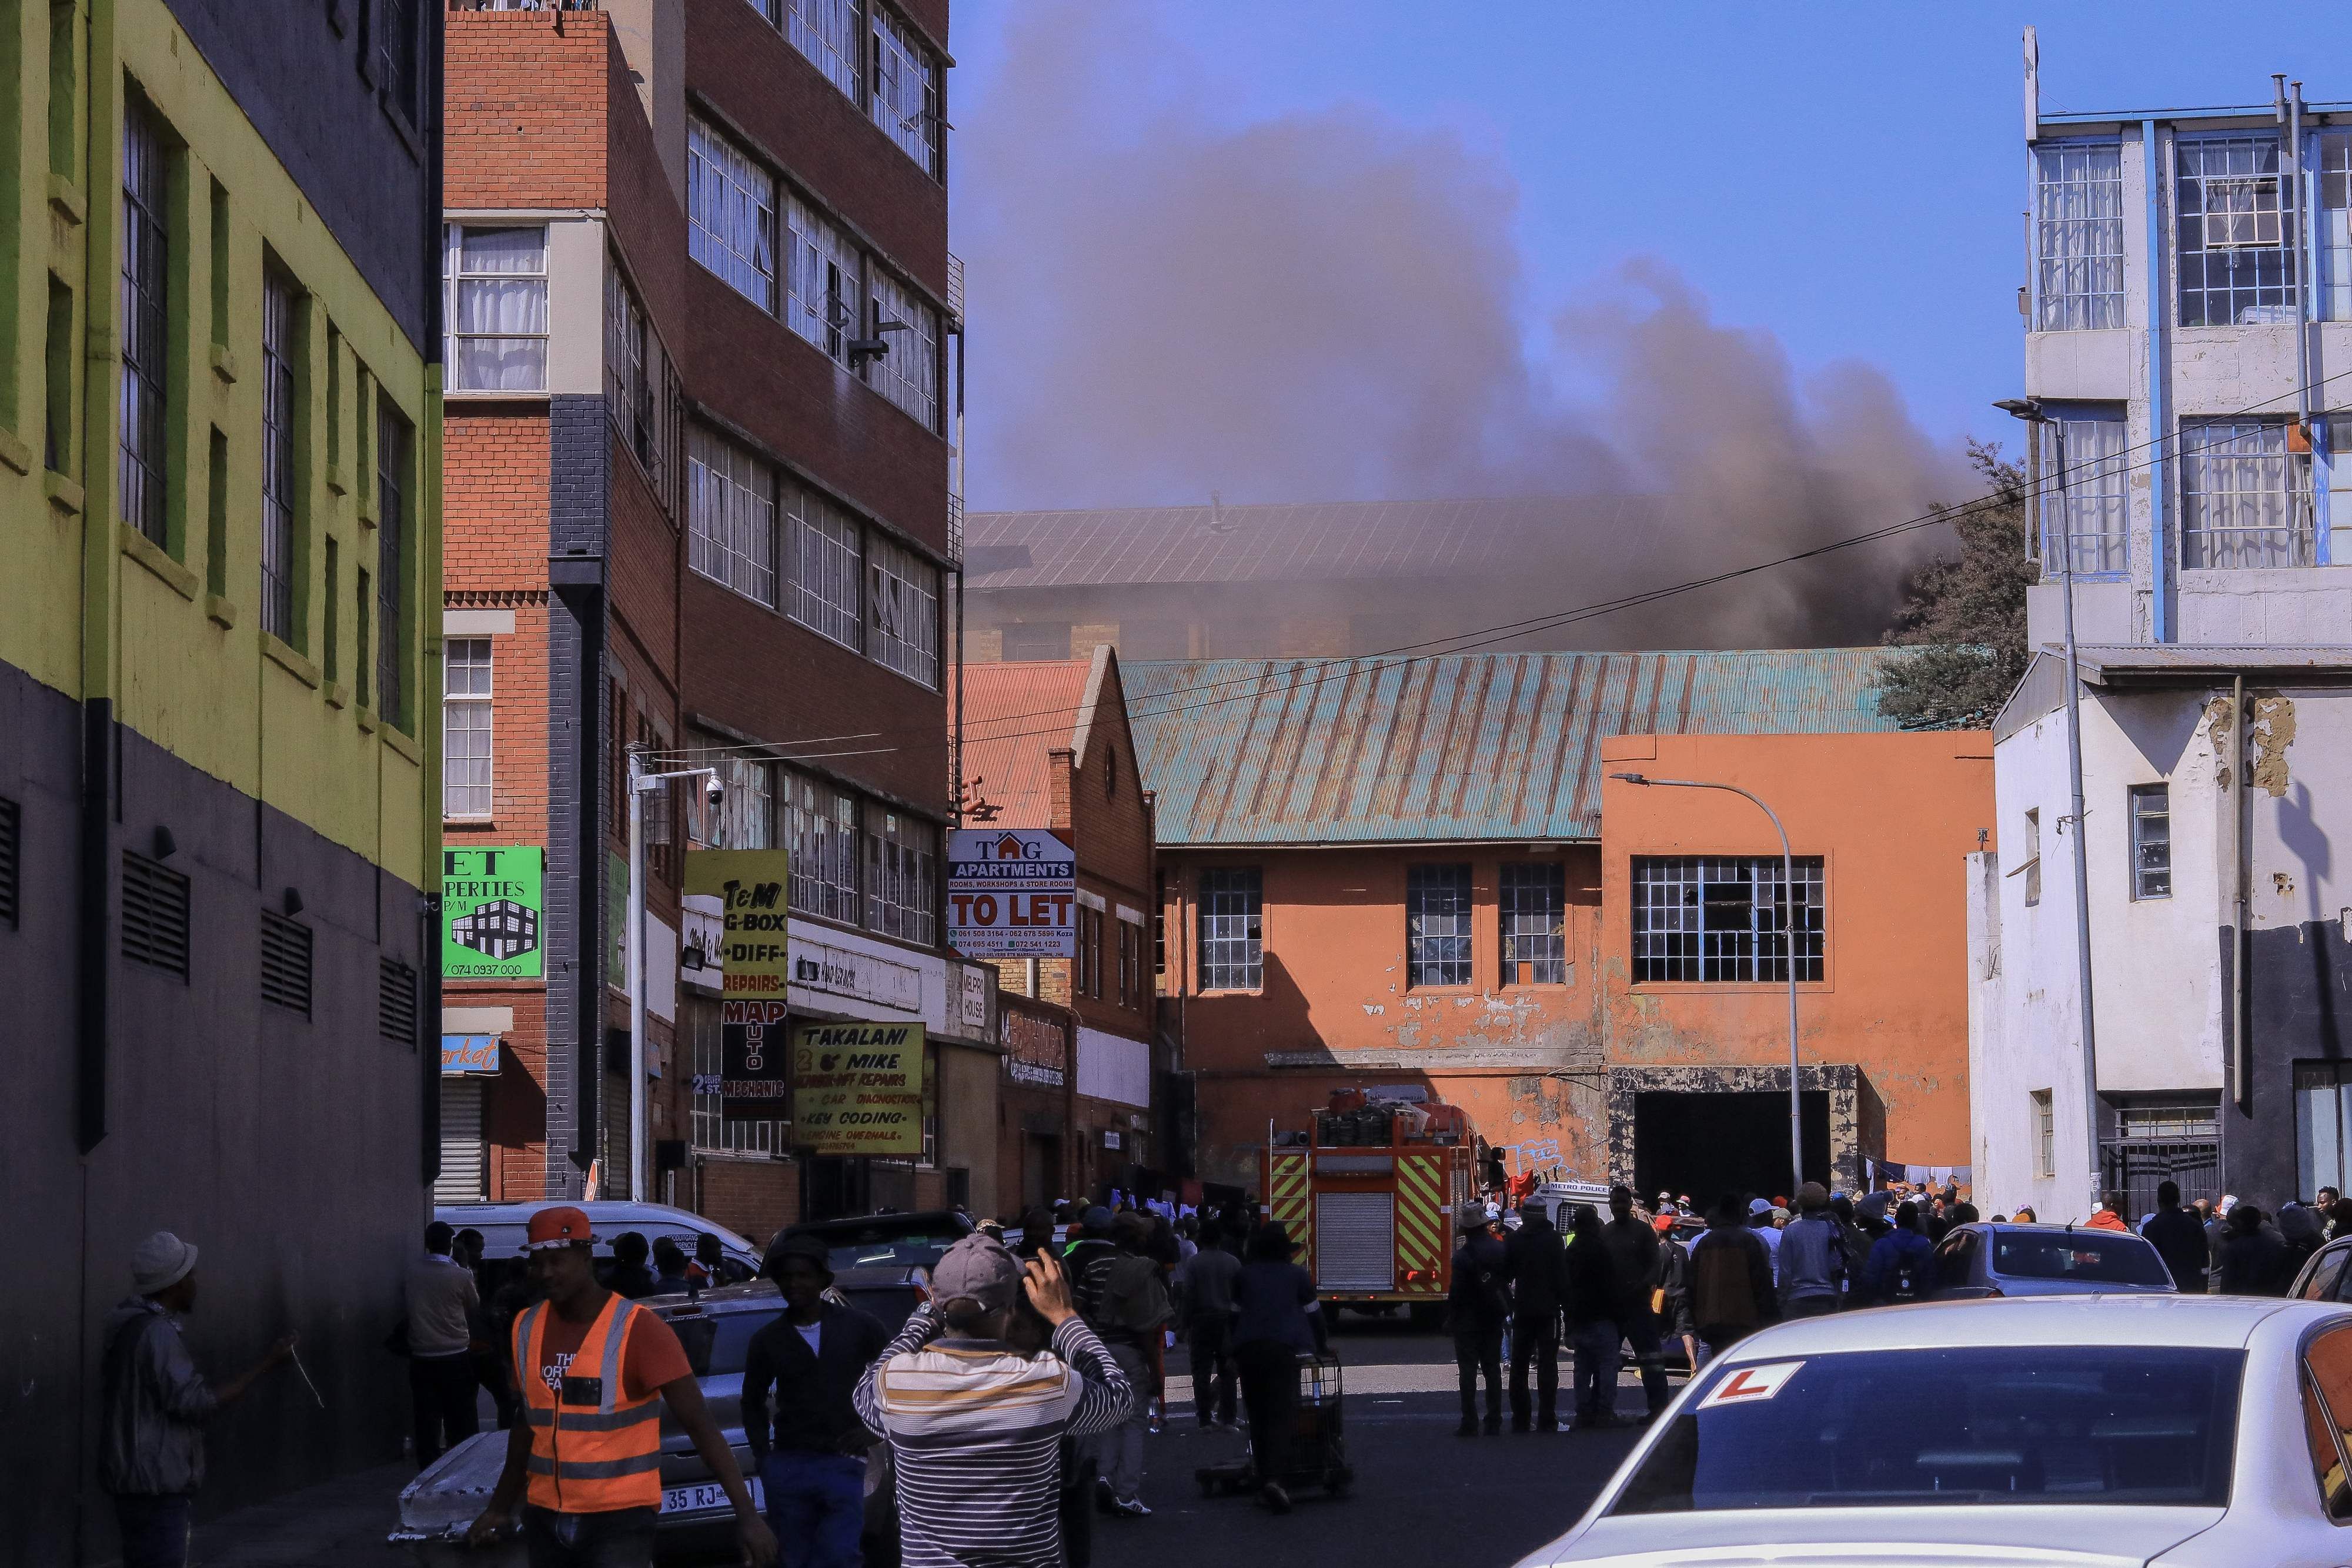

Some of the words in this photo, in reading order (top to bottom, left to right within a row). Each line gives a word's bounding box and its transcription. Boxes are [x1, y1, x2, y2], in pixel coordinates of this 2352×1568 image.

[443, 851, 505, 875] ET
[956, 864, 1069, 876] APARTMENTS
[442, 881, 524, 897] PERTIES
[951, 894, 998, 927] TO
[1009, 894, 1074, 927] LET
[724, 914, 786, 931] G-BOX
[451, 965, 471, 975] 074
[473, 965, 499, 975] 0937
[500, 965, 522, 975] 000
[723, 1001, 787, 1025] MAP
[964, 998, 983, 1019] HOUSE
[803, 1028, 908, 1046] TAKALANI
[442, 1038, 497, 1069] arket
[846, 1054, 901, 1070] MIKE
[693, 1074, 704, 1095] 2
[723, 1080, 784, 1098] MECHANIC
[806, 1112, 833, 1124] KEY
[839, 1112, 902, 1124] CODING
[556, 1353, 577, 1366] TH
[542, 1365, 570, 1378] ORT
[1717, 1370, 1770, 1399] L
